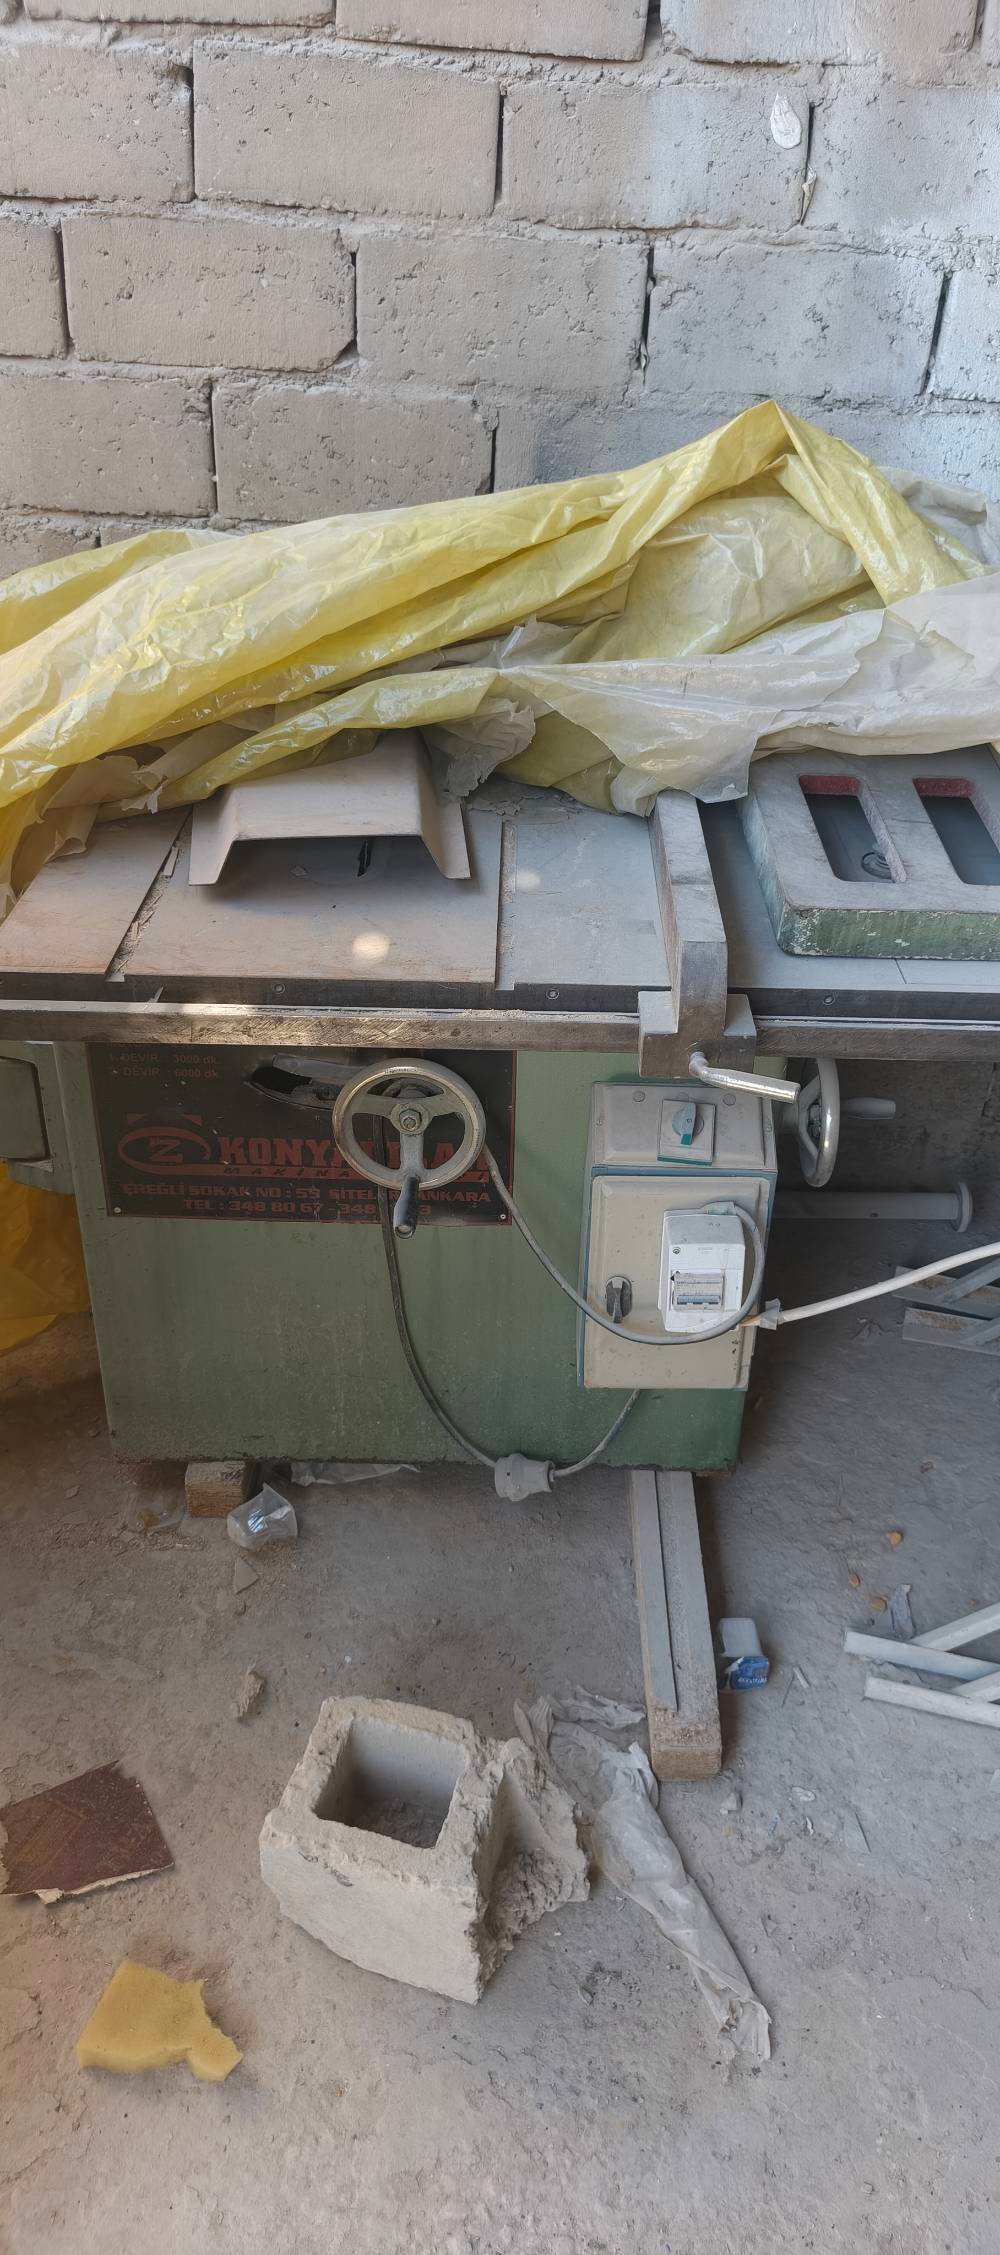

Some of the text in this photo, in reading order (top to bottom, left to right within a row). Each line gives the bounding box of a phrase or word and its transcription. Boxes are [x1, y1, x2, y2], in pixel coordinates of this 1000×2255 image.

[189, 1184, 249, 1196] SOKAK
[256, 1187, 281, 1198] NO
[184, 1199, 216, 1211] TEL
[229, 1200, 266, 1212] 348
[340, 1203, 376, 1215] 348
